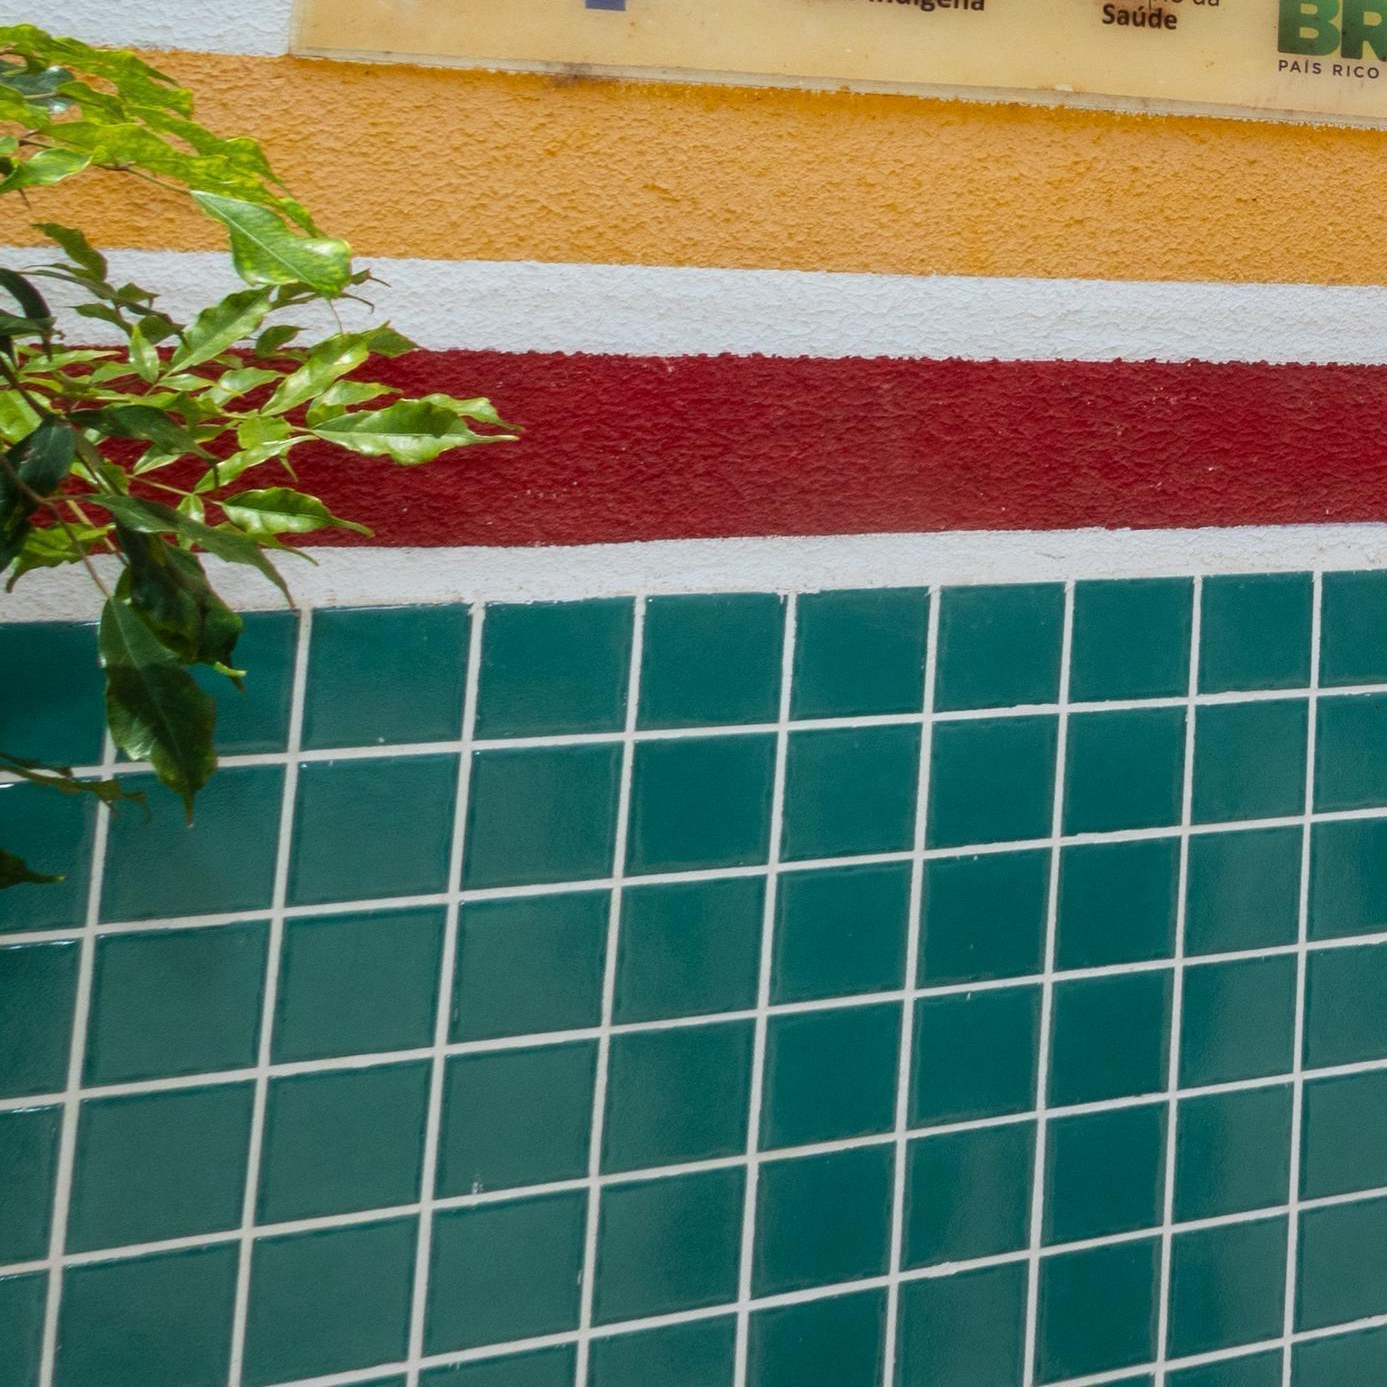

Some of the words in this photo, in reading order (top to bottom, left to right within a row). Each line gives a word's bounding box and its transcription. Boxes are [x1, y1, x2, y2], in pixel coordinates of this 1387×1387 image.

[1100, 2, 1179, 31] Saúde
[1278, 58, 1323, 75] PAÍS
[1332, 64, 1380, 80] RICO
